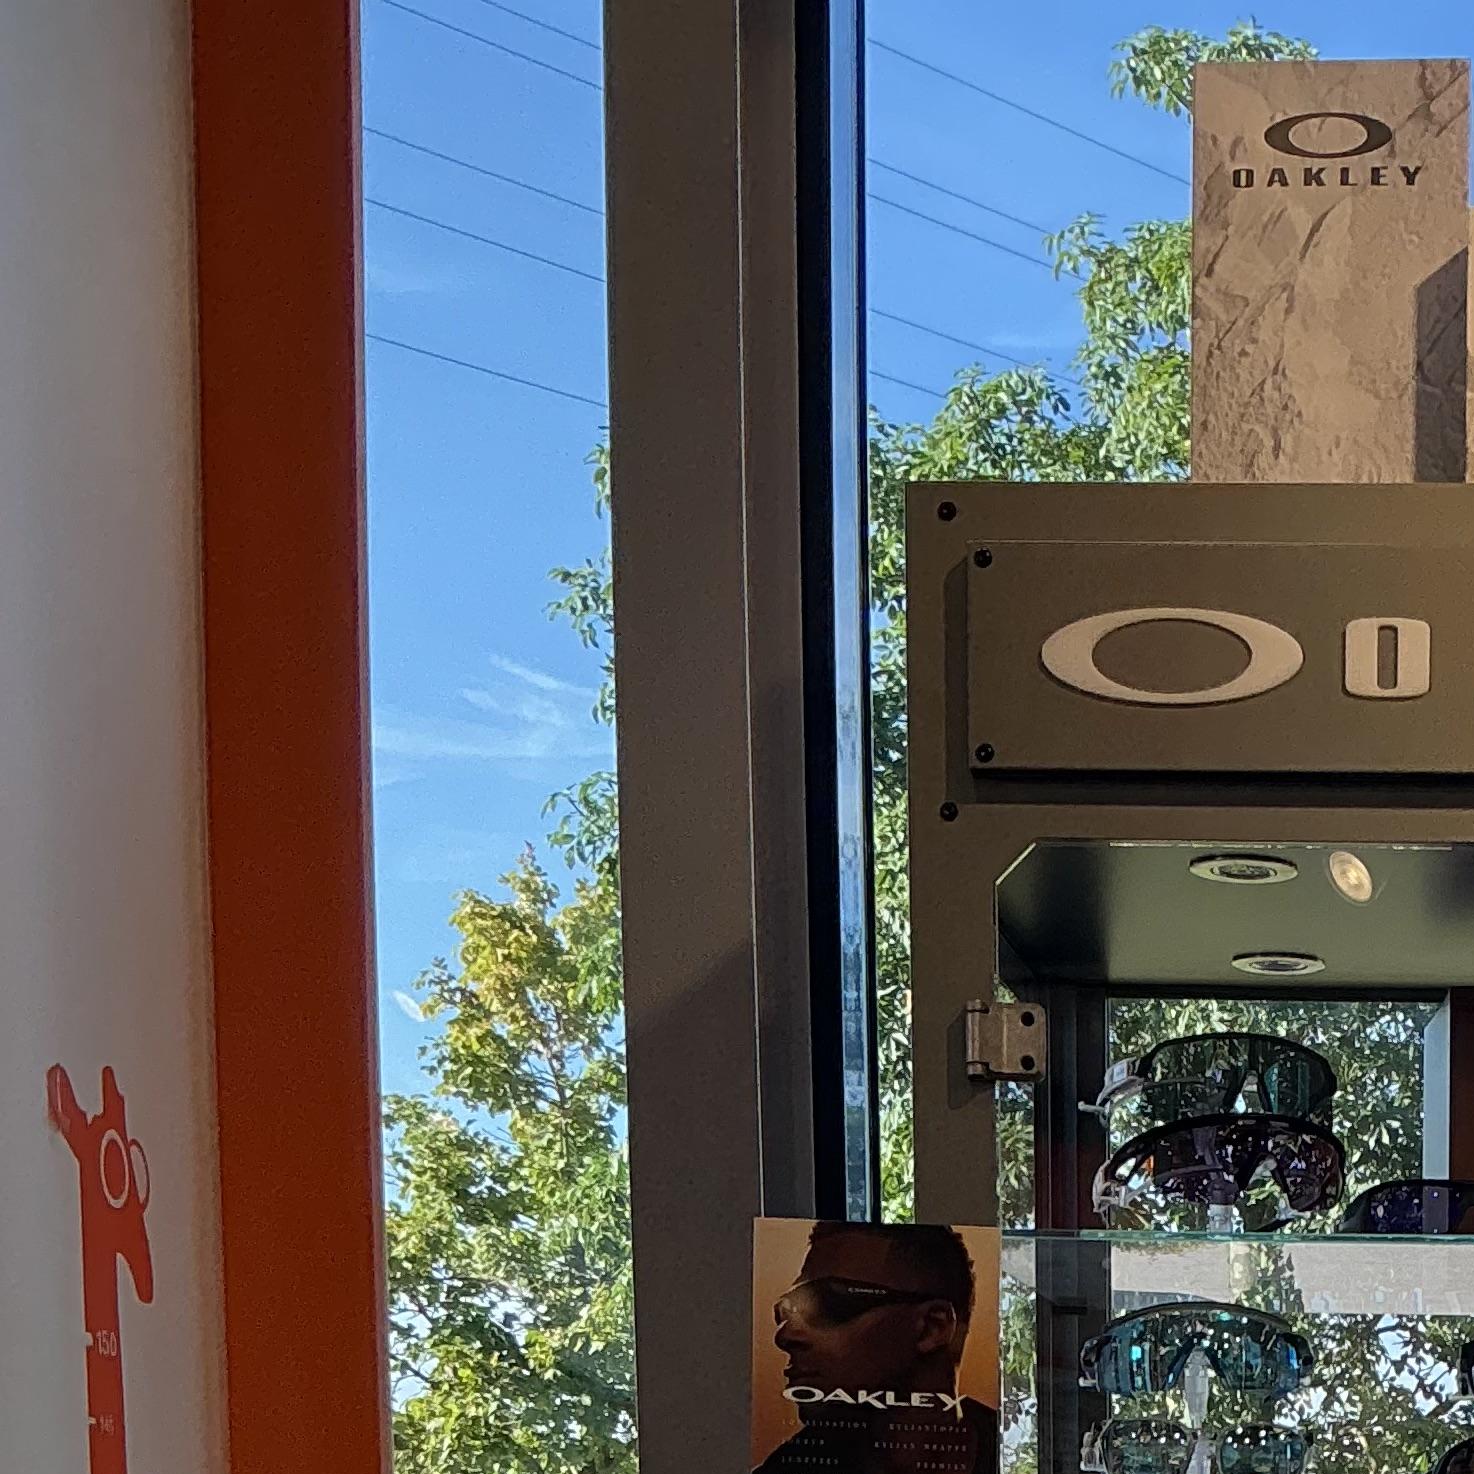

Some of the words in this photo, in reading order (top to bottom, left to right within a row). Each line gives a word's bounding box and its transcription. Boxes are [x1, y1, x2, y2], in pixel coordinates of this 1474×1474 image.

[1231, 164, 1424, 190] OAKLEY
[96, 1330, 118, 1357] 150
[781, 1385, 968, 1421] OAKLEY
